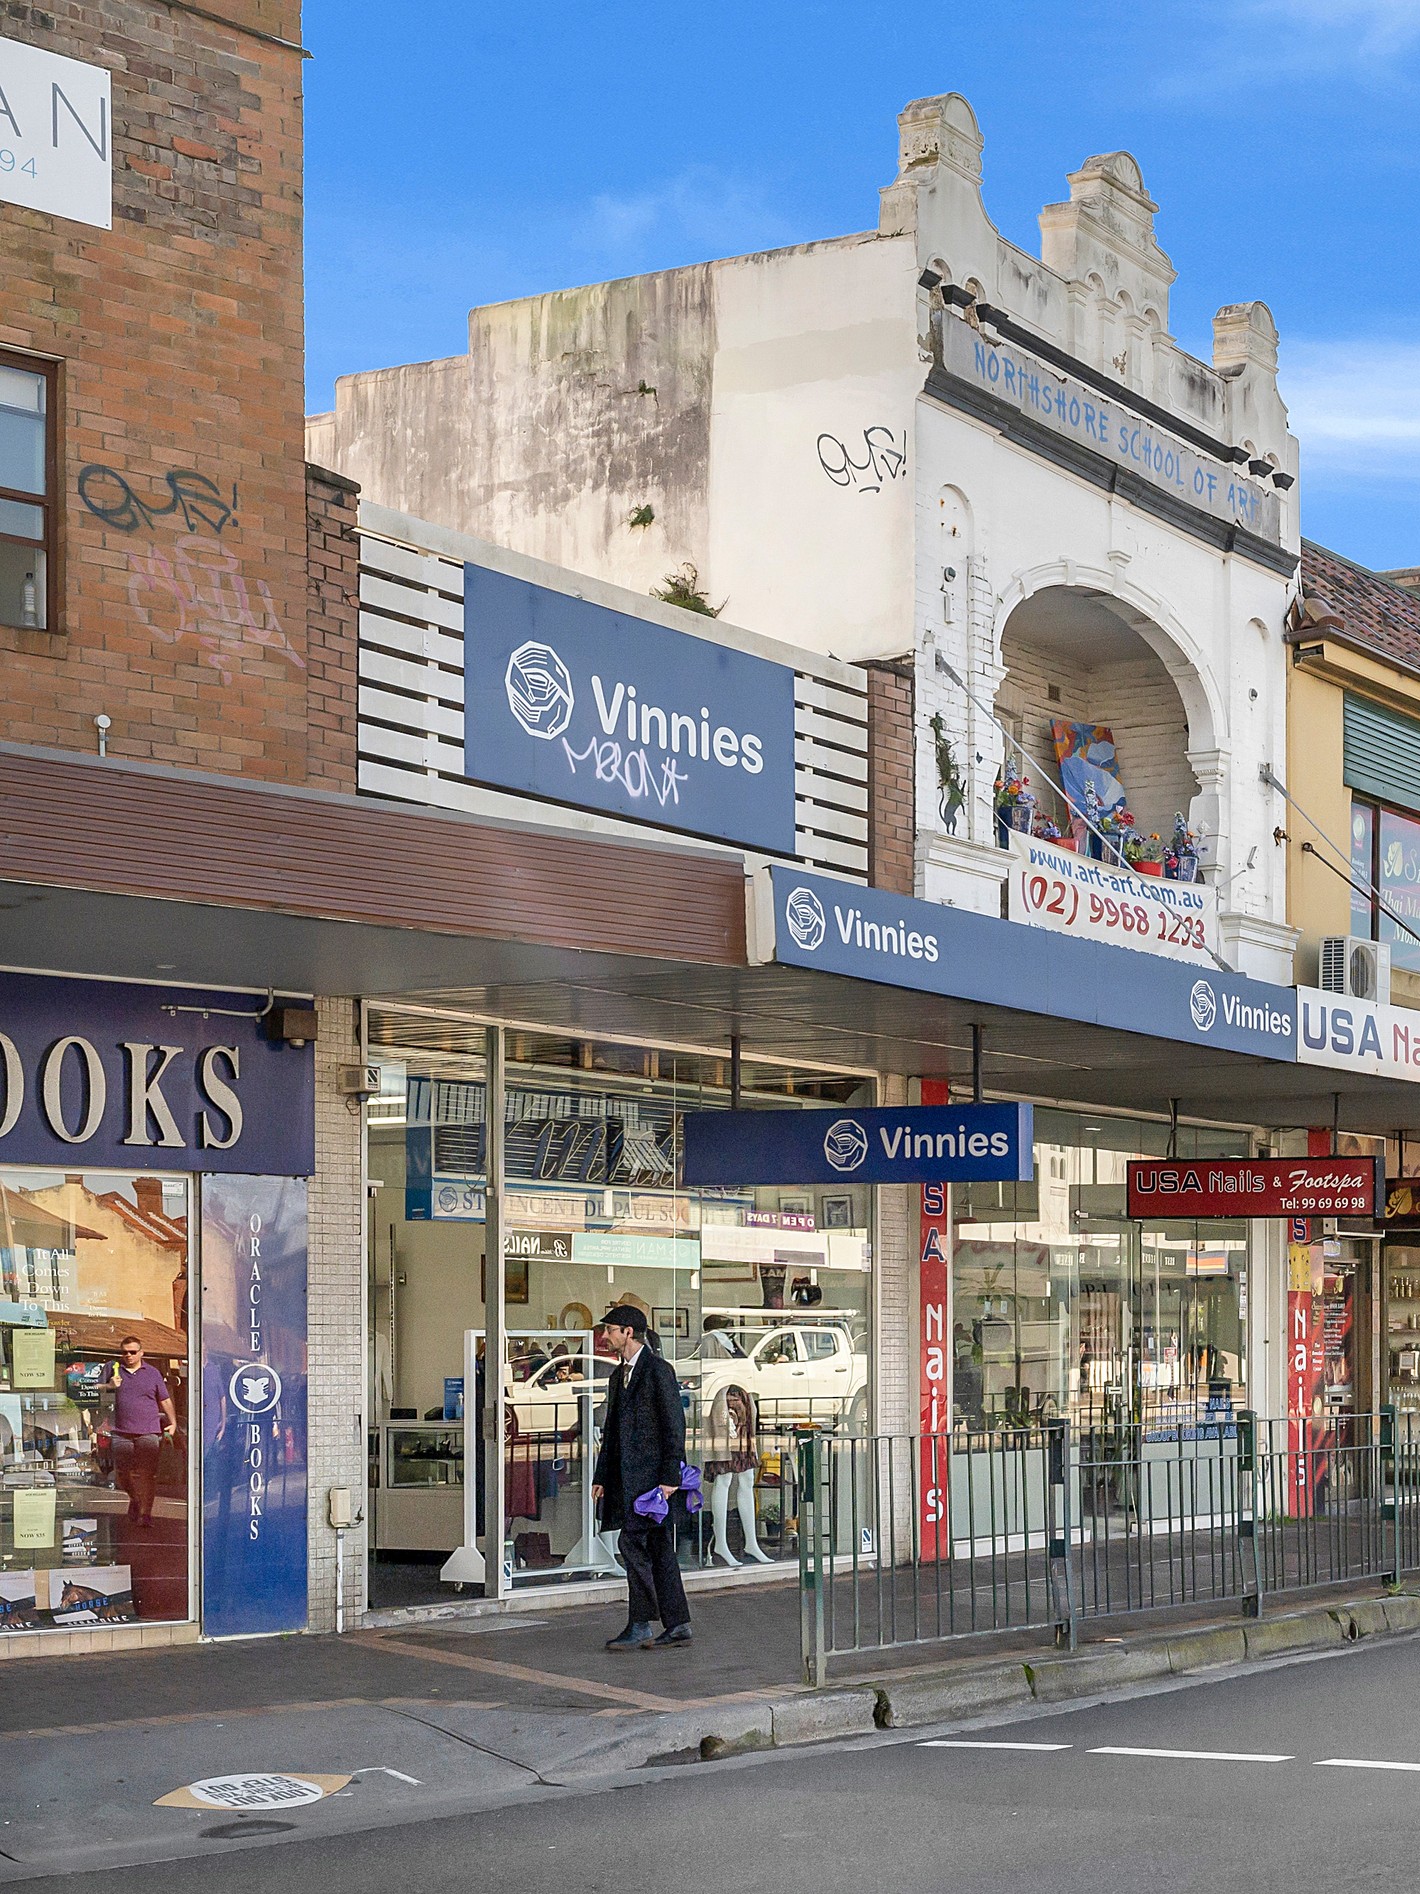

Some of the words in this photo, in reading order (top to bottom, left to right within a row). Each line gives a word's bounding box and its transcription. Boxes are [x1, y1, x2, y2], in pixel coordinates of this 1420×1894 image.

[973, 341, 1110, 443] NORTHSHORE
[1118, 425, 1184, 486] SCHOOL
[1193, 466, 1218, 502] OF
[1227, 483, 1260, 521] ART
[591, 675, 764, 774] Vinnies
[1029, 847, 1204, 910] www.art-art.com.au
[1021, 870, 1080, 926] (02)
[1089, 892, 1151, 936] 9968
[1381, 888, 1404, 914] Thai
[834, 904, 940, 963] Vinnies
[1221, 993, 1292, 1037] Vinnies
[1302, 1002, 1384, 1060] USA
[879, 1124, 1009, 1160] Vinnies
[1136, 1170, 1203, 1194] USA
[1208, 1170, 1266, 1193] Nails
[1272, 1175, 1282, 1187] &
[462, 1192, 486, 1211] ST
[504, 1195, 578, 1217] INCENT
[585, 1199, 607, 1217] DE
[613, 1201, 655, 1220] PAUL
[1280, 1198, 1300, 1210] Tel:
[1302, 1198, 1316, 1210] 99
[1318, 1198, 1333, 1210] 69
[1334, 1198, 1349, 1210] 69
[1351, 1197, 1365, 1209] 98
[22, 1264, 70, 1277] Comes
[36, 1249, 47, 1260] It
[50, 1248, 70, 1260] All
[27, 1281, 70, 1295] Down
[249, 1212, 262, 1352] ORACLE
[22, 1299, 38, 1312] To
[42, 1299, 70, 1312] This
[249, 1424, 262, 1541] BOOKS
[74, 1598, 109, 1611] HORSE
